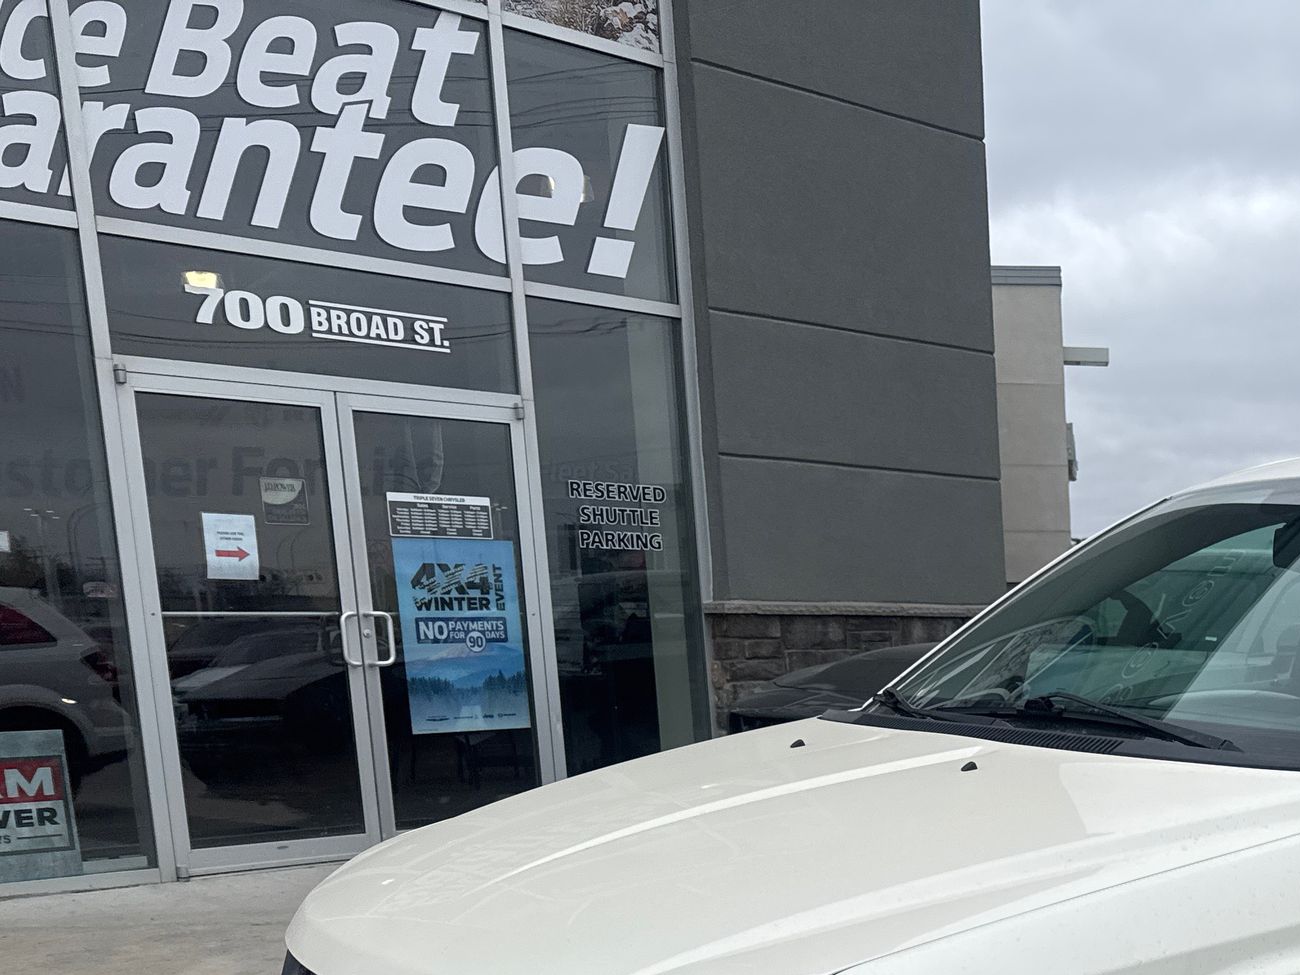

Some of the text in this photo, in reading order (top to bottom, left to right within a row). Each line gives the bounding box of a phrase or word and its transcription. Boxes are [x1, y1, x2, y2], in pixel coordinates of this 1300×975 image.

[145, 0, 480, 127] Beat
[184, 283, 451, 347] 700 BROAD ST.
[568, 479, 667, 504] RESERVED
[579, 505, 661, 527] SHUTTLE
[578, 529, 664, 552] PARKING
[492, 563, 506, 611] EVENT
[414, 597, 492, 612] WINTER
[418, 621, 505, 640] NO PAYMENTS
[449, 631, 506, 649] FOR 90 DAYS
